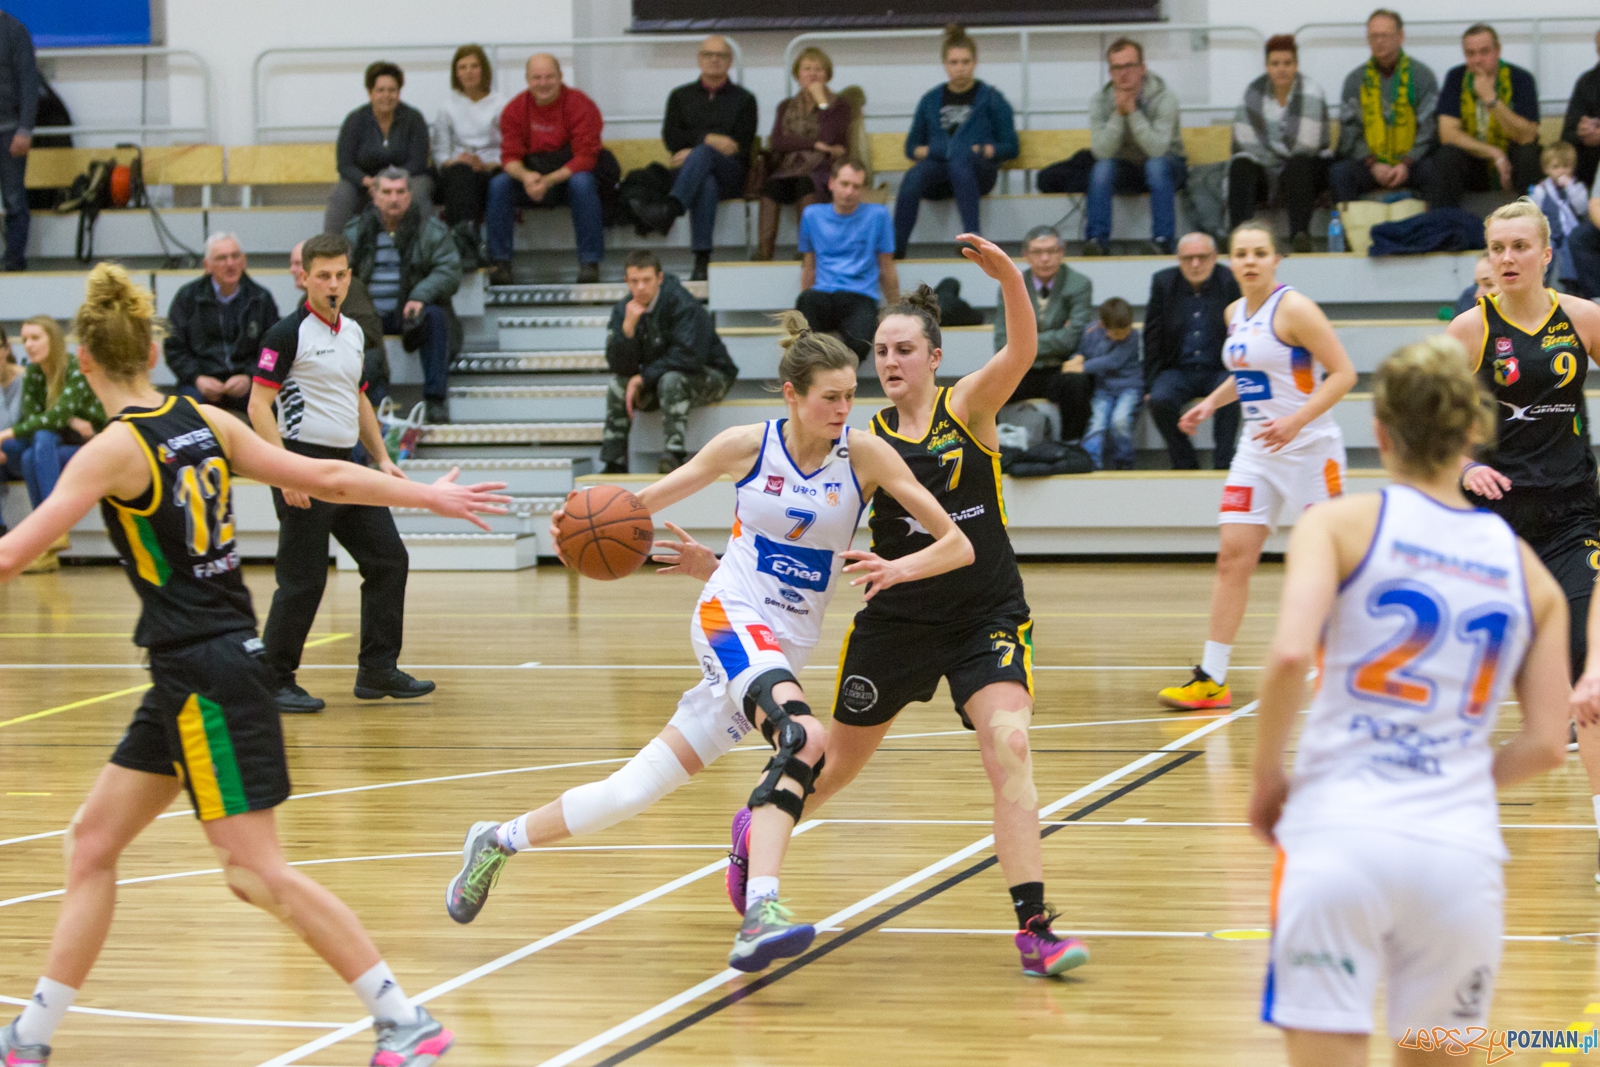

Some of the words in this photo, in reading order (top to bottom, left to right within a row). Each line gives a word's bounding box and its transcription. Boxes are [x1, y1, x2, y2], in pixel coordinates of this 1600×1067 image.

[1550, 351, 1577, 388] 9
[938, 447, 963, 492] 7
[172, 456, 236, 556] 12
[785, 507, 816, 541] 7
[772, 560, 821, 581] Enea
[992, 640, 1016, 669] 7
[1346, 577, 1518, 726] 21
